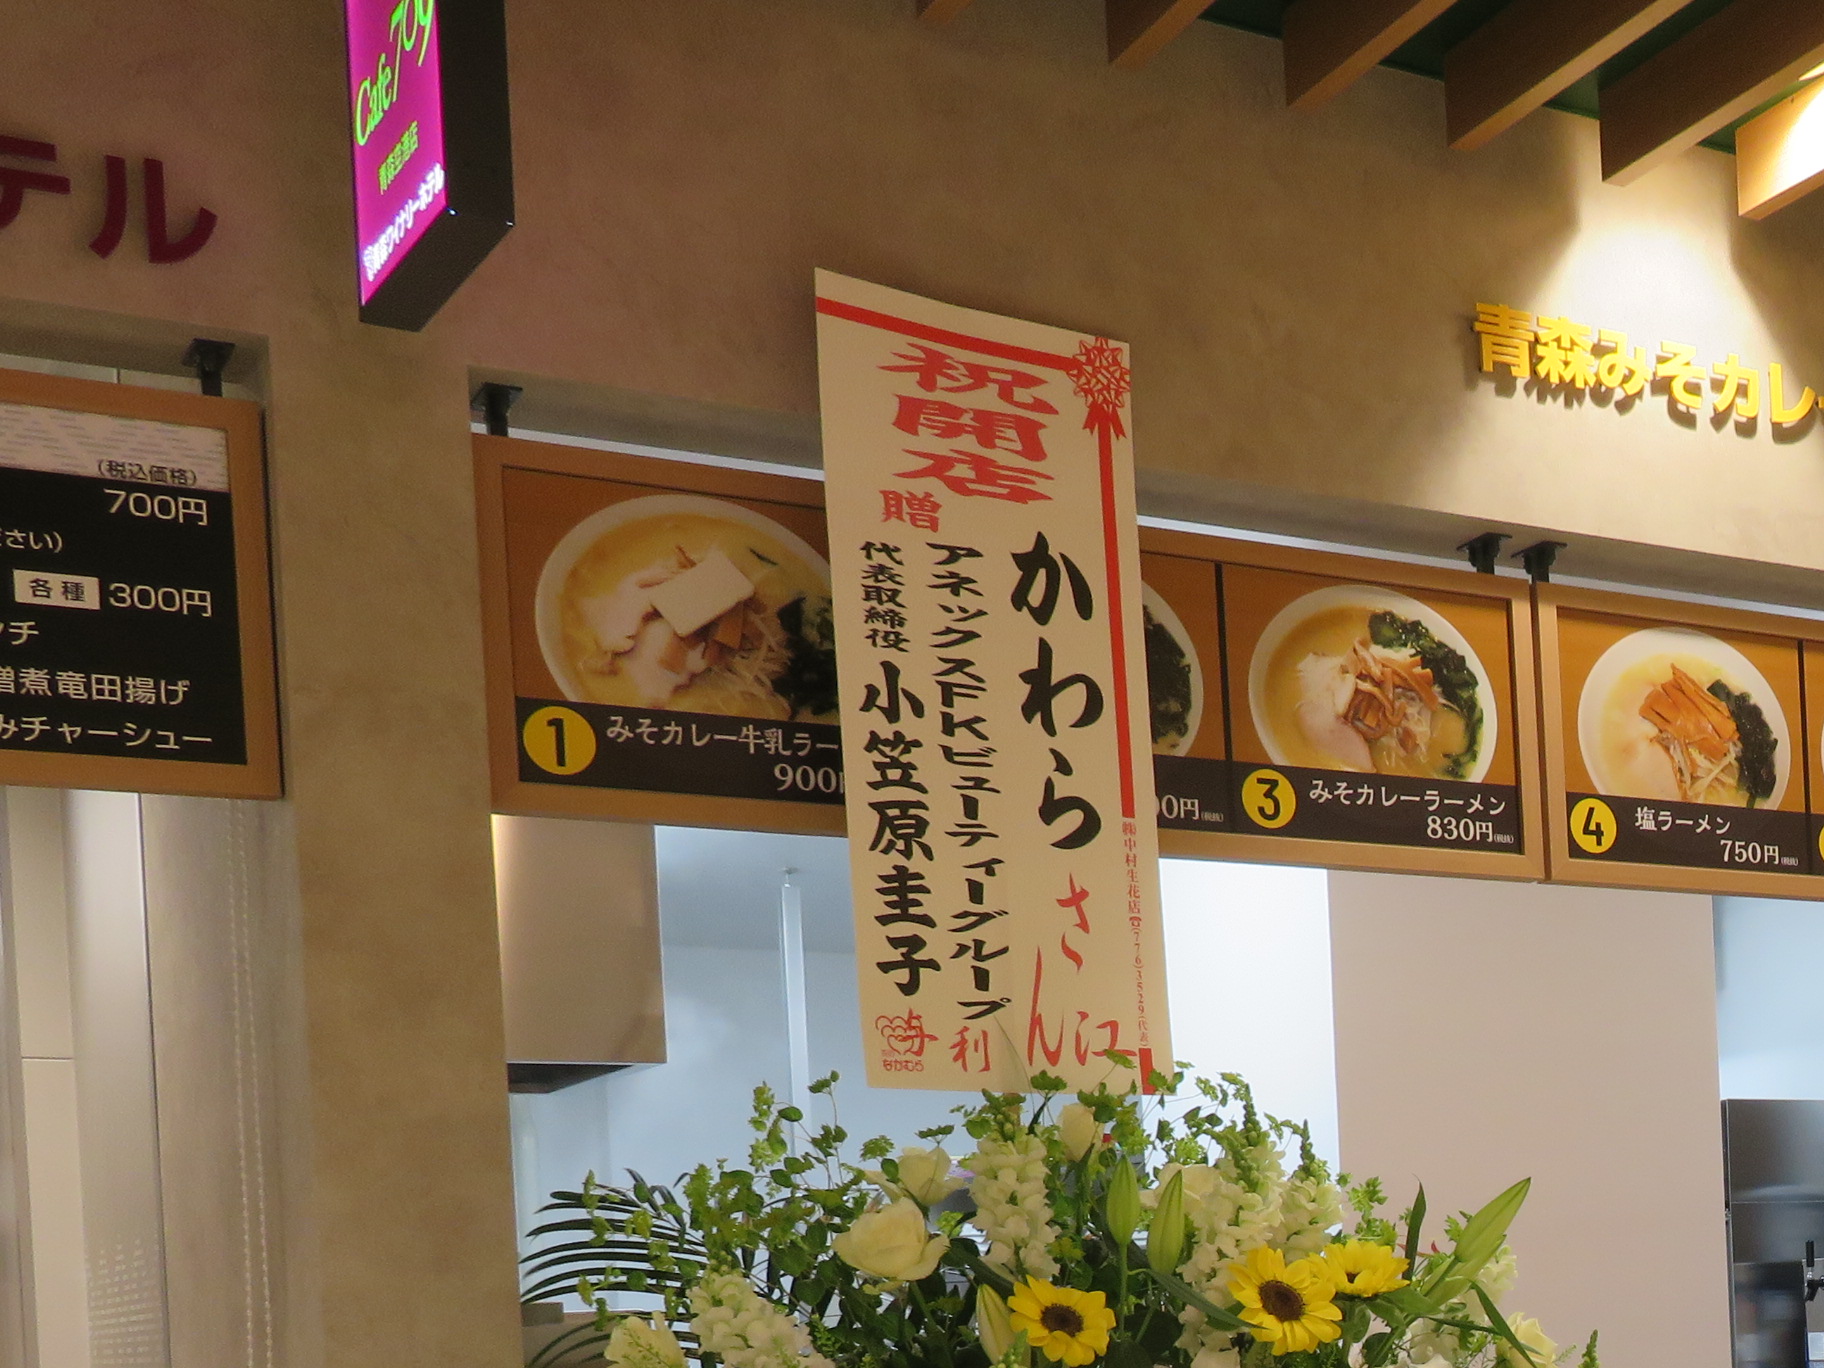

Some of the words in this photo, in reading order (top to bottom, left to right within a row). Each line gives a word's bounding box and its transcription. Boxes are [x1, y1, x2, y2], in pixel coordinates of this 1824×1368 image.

[354, 53, 392, 145] Cafe
[876, 342, 1060, 505] 祝開店
[98, 459, 198, 486] (税込価格)
[104, 488, 209, 527] 700円
[879, 490, 943, 534] 贈
[0, 528, 63, 553] さい)
[28, 577, 88, 603] 各種
[108, 582, 213, 618] 300円
[859, 540, 911, 653] 代表取締役
[0, 620, 40, 646] チ
[1010, 530, 1106, 850] かわら
[546, 717, 567, 768] 1
[606, 715, 839, 757] みそカレー牛乳ラー
[772, 763, 846, 794] 900
[925, 541, 1012, 1021] アネックスFKビューティーグループ
[1154, 794, 1200, 821] 0円
[1255, 777, 1282, 822] 3
[1309, 779, 1507, 816] みそカレーラーメン
[858, 660, 942, 997] 小笠原圭子
[1426, 815, 1493, 844] 830円
[1582, 806, 1605, 848] 4
[1634, 806, 1732, 836] 塩ラーメン
[1719, 839, 1780, 866] 750円
[882, 1059, 925, 1073] なかむら
